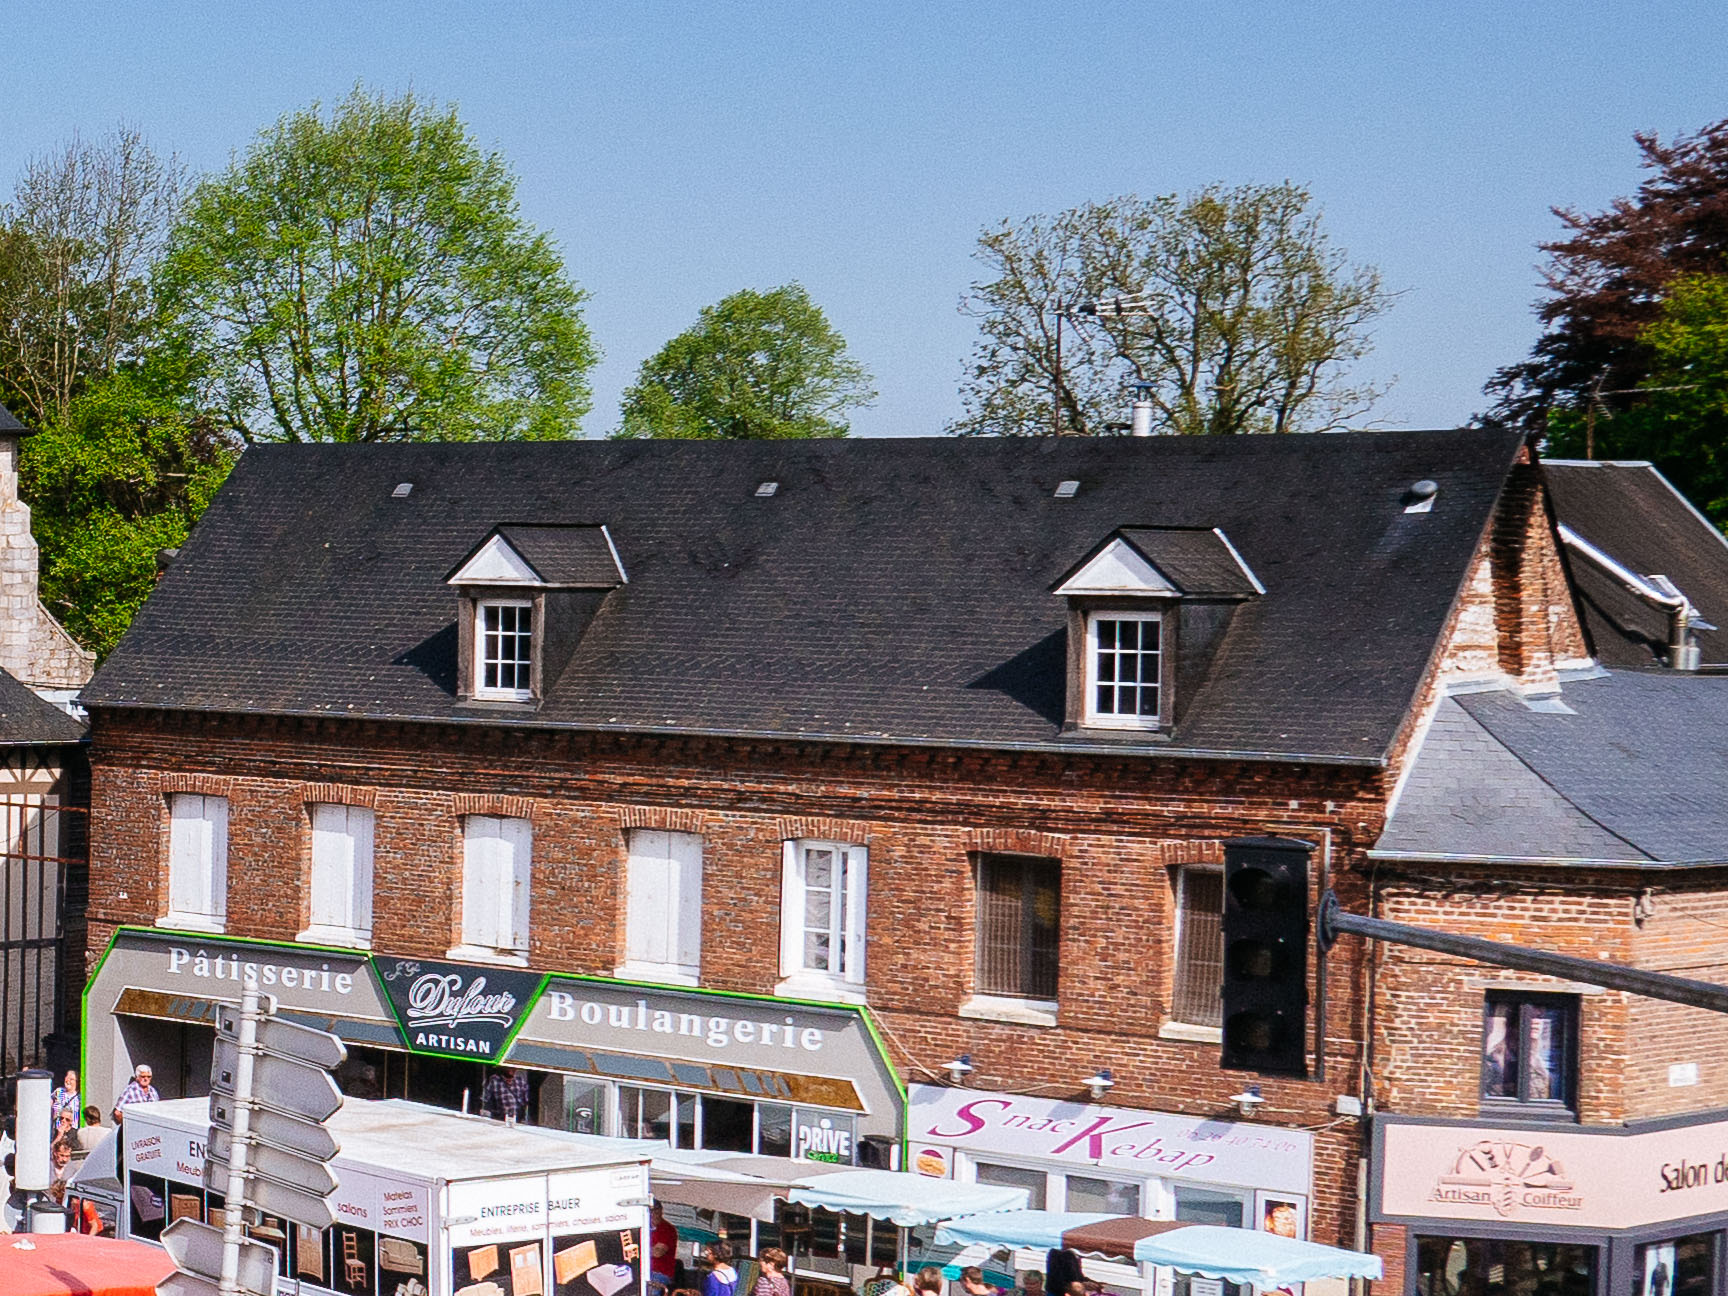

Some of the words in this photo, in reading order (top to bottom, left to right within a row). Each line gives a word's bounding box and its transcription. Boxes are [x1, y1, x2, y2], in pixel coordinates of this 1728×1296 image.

[166, 946, 354, 995] Pâtisserie
[407, 973, 517, 1028] Dufour
[546, 990, 825, 1051] Boulangerie
[416, 1032, 491, 1055] ARTISAN
[1660, 1157, 1708, 1194] Salon
[481, 1202, 540, 1218] ENTREPRISE
[547, 1197, 581, 1211] BAUER
[1433, 1186, 1491, 1203] Artisan
[1523, 1192, 1583, 1208] Coiffeur
